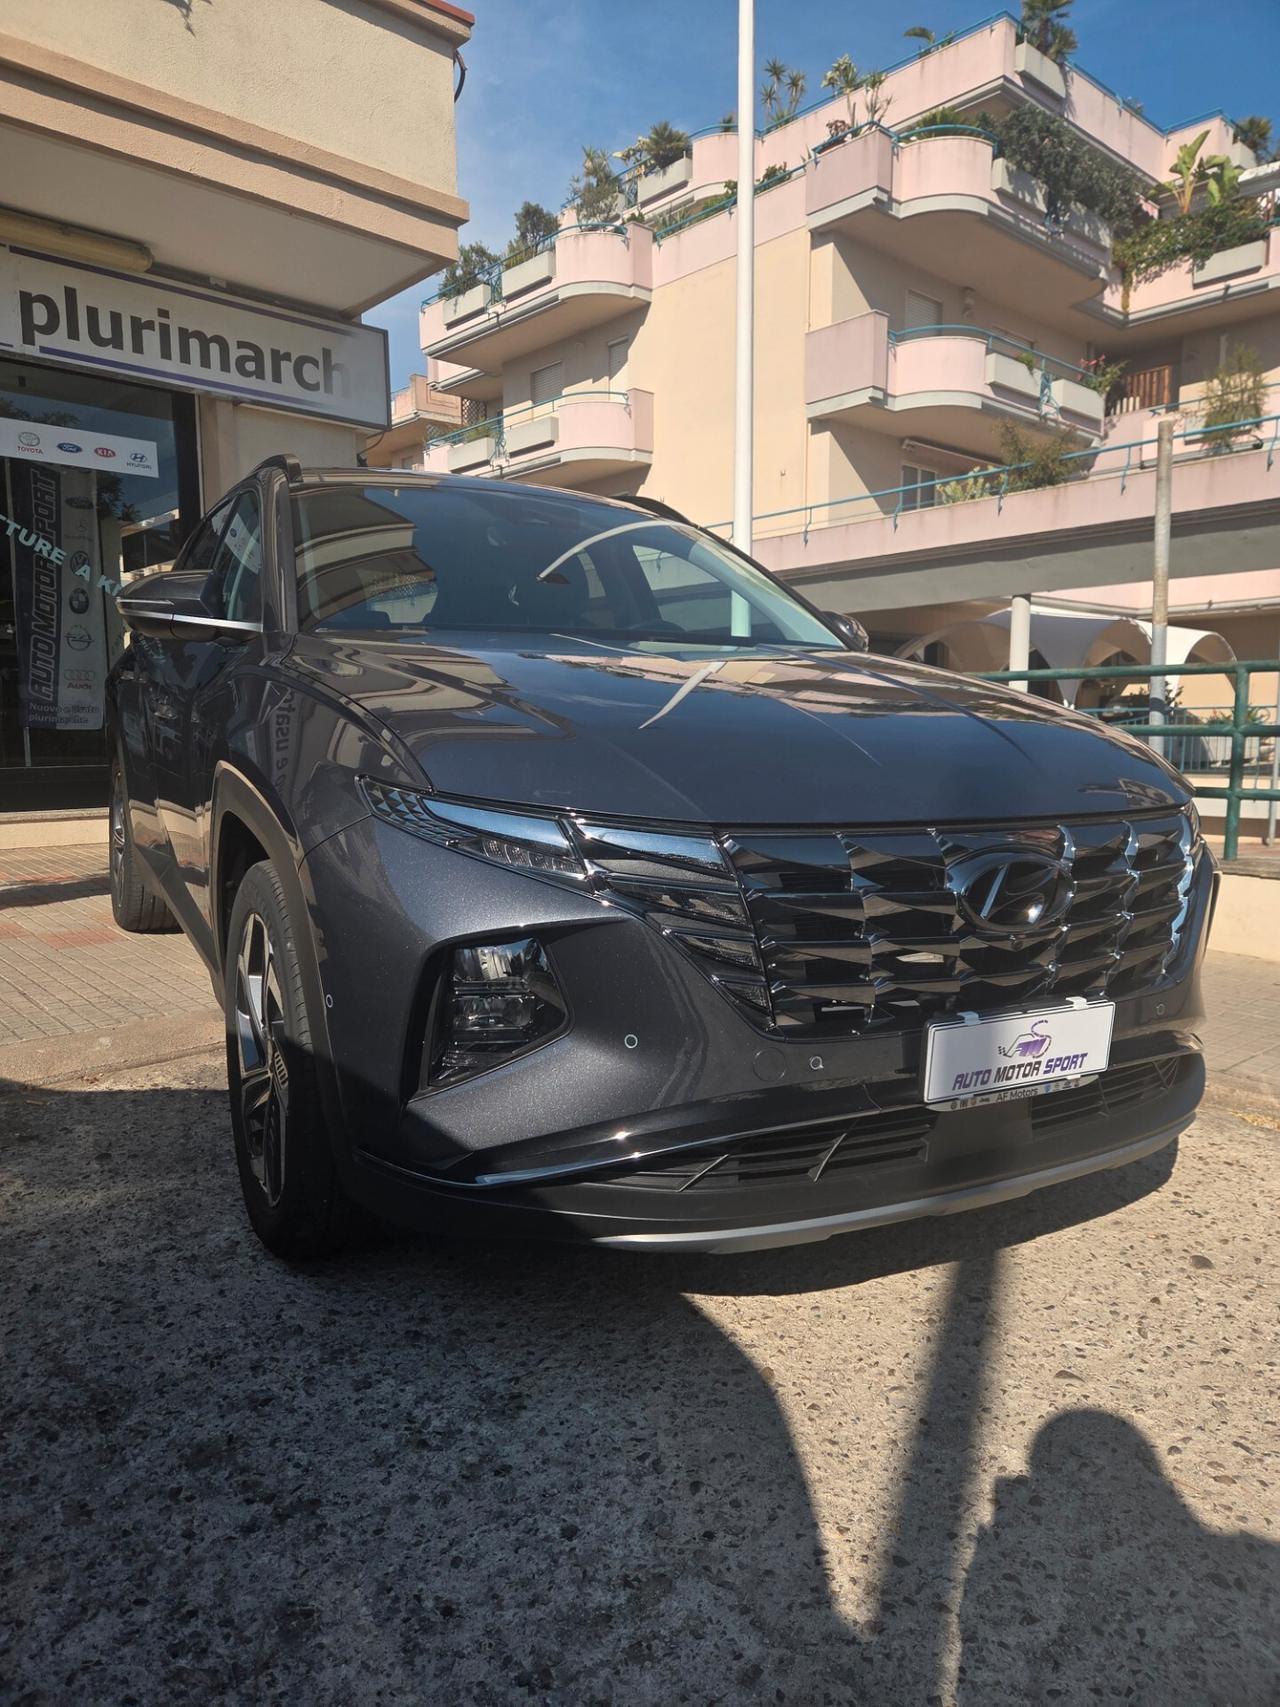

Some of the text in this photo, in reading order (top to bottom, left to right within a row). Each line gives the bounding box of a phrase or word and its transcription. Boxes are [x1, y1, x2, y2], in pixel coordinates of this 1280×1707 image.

[17, 445, 44, 455] TOYOTA
[95, 447, 115, 458] KIA
[0, 513, 67, 566] TURE
[74, 565, 91, 582] A
[28, 468, 57, 701] AUTO MOTOR PORT
[952, 1053, 1088, 1091] AUTO MOTOR SPORT
[996, 1091, 1009, 1101] AF
[1010, 1088, 1039, 1100] Motors
